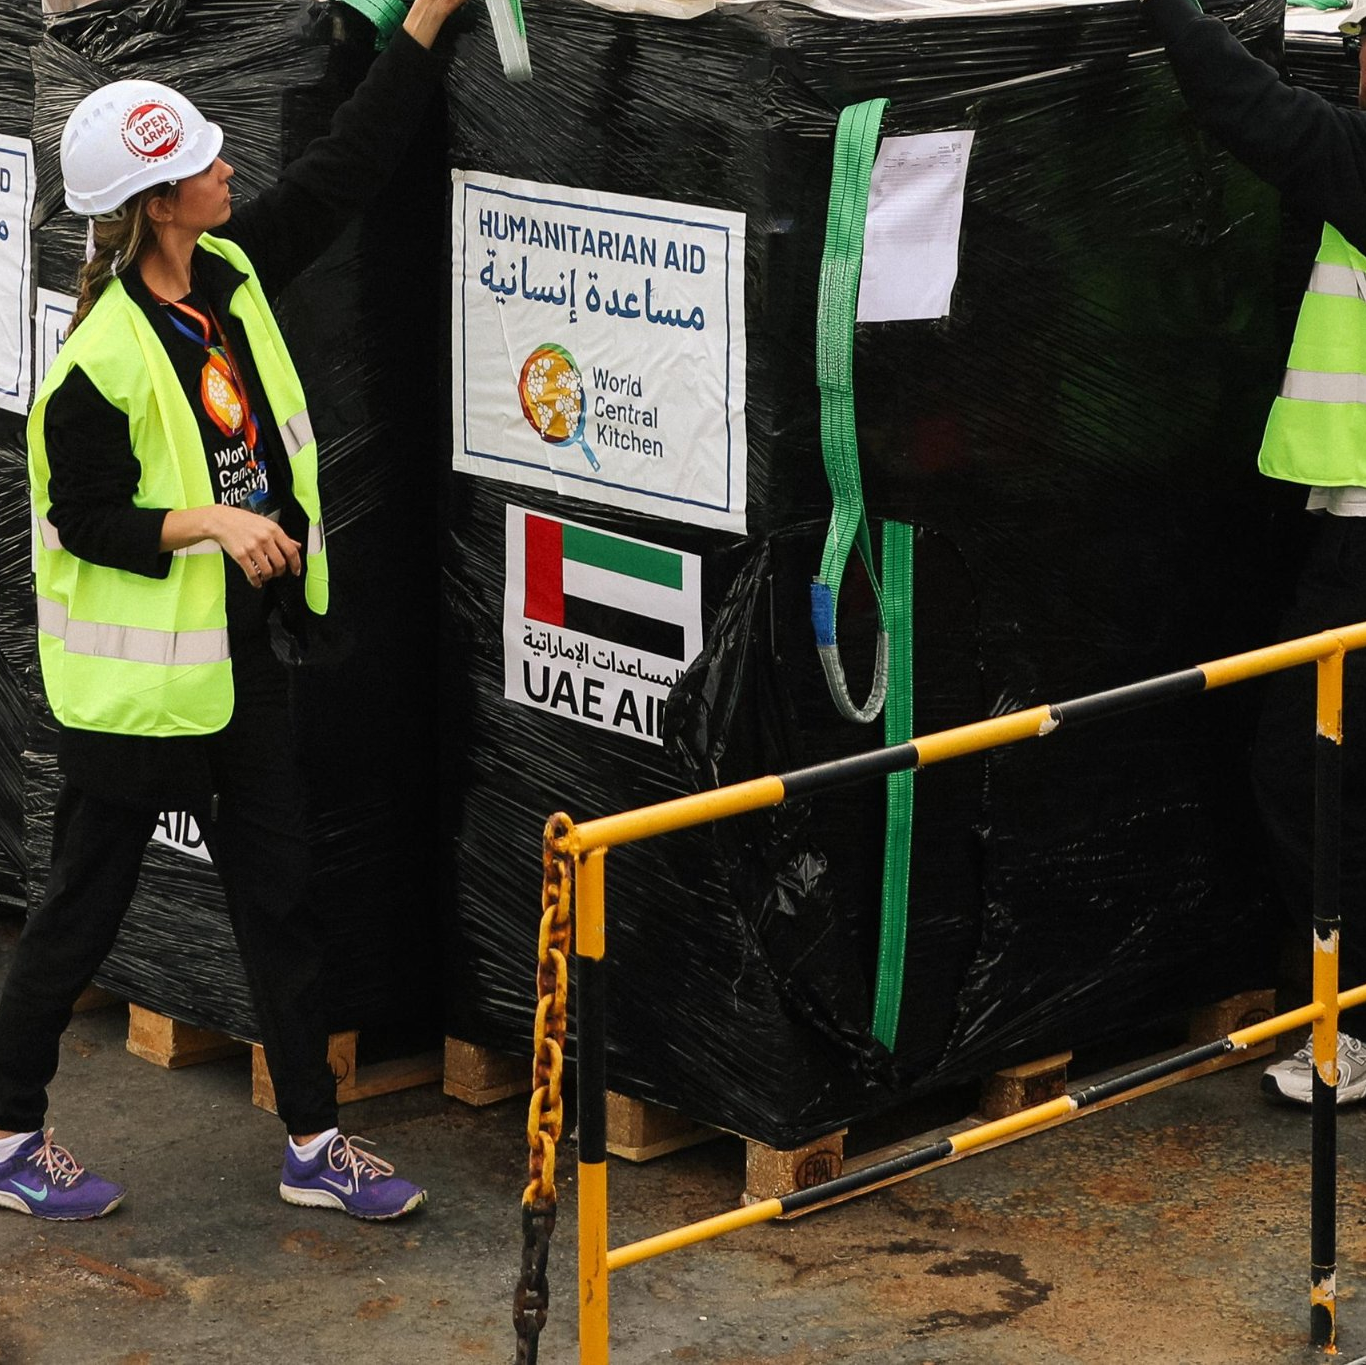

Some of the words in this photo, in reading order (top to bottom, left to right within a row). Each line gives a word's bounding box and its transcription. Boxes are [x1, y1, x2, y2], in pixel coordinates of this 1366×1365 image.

[135, 113, 168, 136] OPEN
[143, 122, 173, 147] ARMS
[478, 208, 657, 267] HUMANITARIAN
[664, 240, 706, 274] AID
[479, 248, 577, 324] إنسانية
[585, 271, 706, 331] مساعدة
[593, 366, 643, 398] World
[594, 396, 658, 429] Central
[596, 422, 664, 458] Kitchen
[523, 624, 589, 669] الإماراتية
[522, 659, 605, 723] UAE
